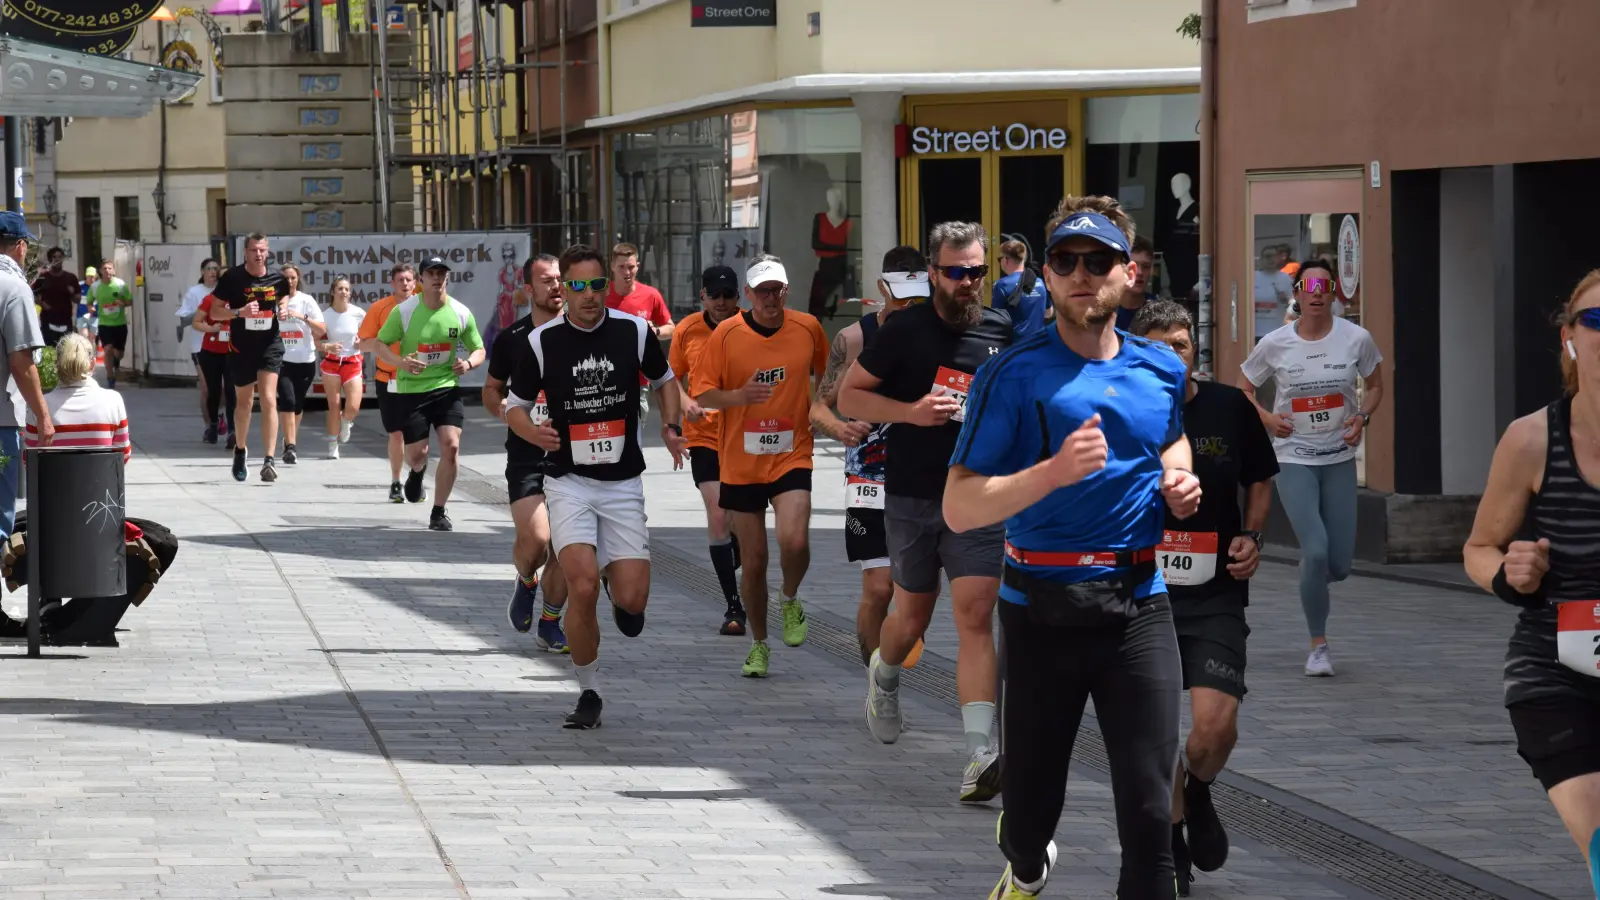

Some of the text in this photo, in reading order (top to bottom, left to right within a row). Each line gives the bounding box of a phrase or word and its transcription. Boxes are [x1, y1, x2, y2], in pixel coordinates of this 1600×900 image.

[98, 12, 120, 25] 48
[121, 3, 143, 19] 32
[705, 6, 770, 17] Street One
[98, 39, 117, 53] 32
[912, 123, 1067, 154] Street One
[265, 249, 293, 266] eu
[427, 353, 441, 361] 577
[536, 405, 549, 415] 18
[564, 401, 573, 410] 12.
[573, 397, 603, 410] Ansbacher
[1309, 412, 1330, 423] 193
[759, 434, 779, 445] 462
[589, 440, 613, 454] 113
[856, 485, 878, 498] 165
[1161, 554, 1193, 570] 140
